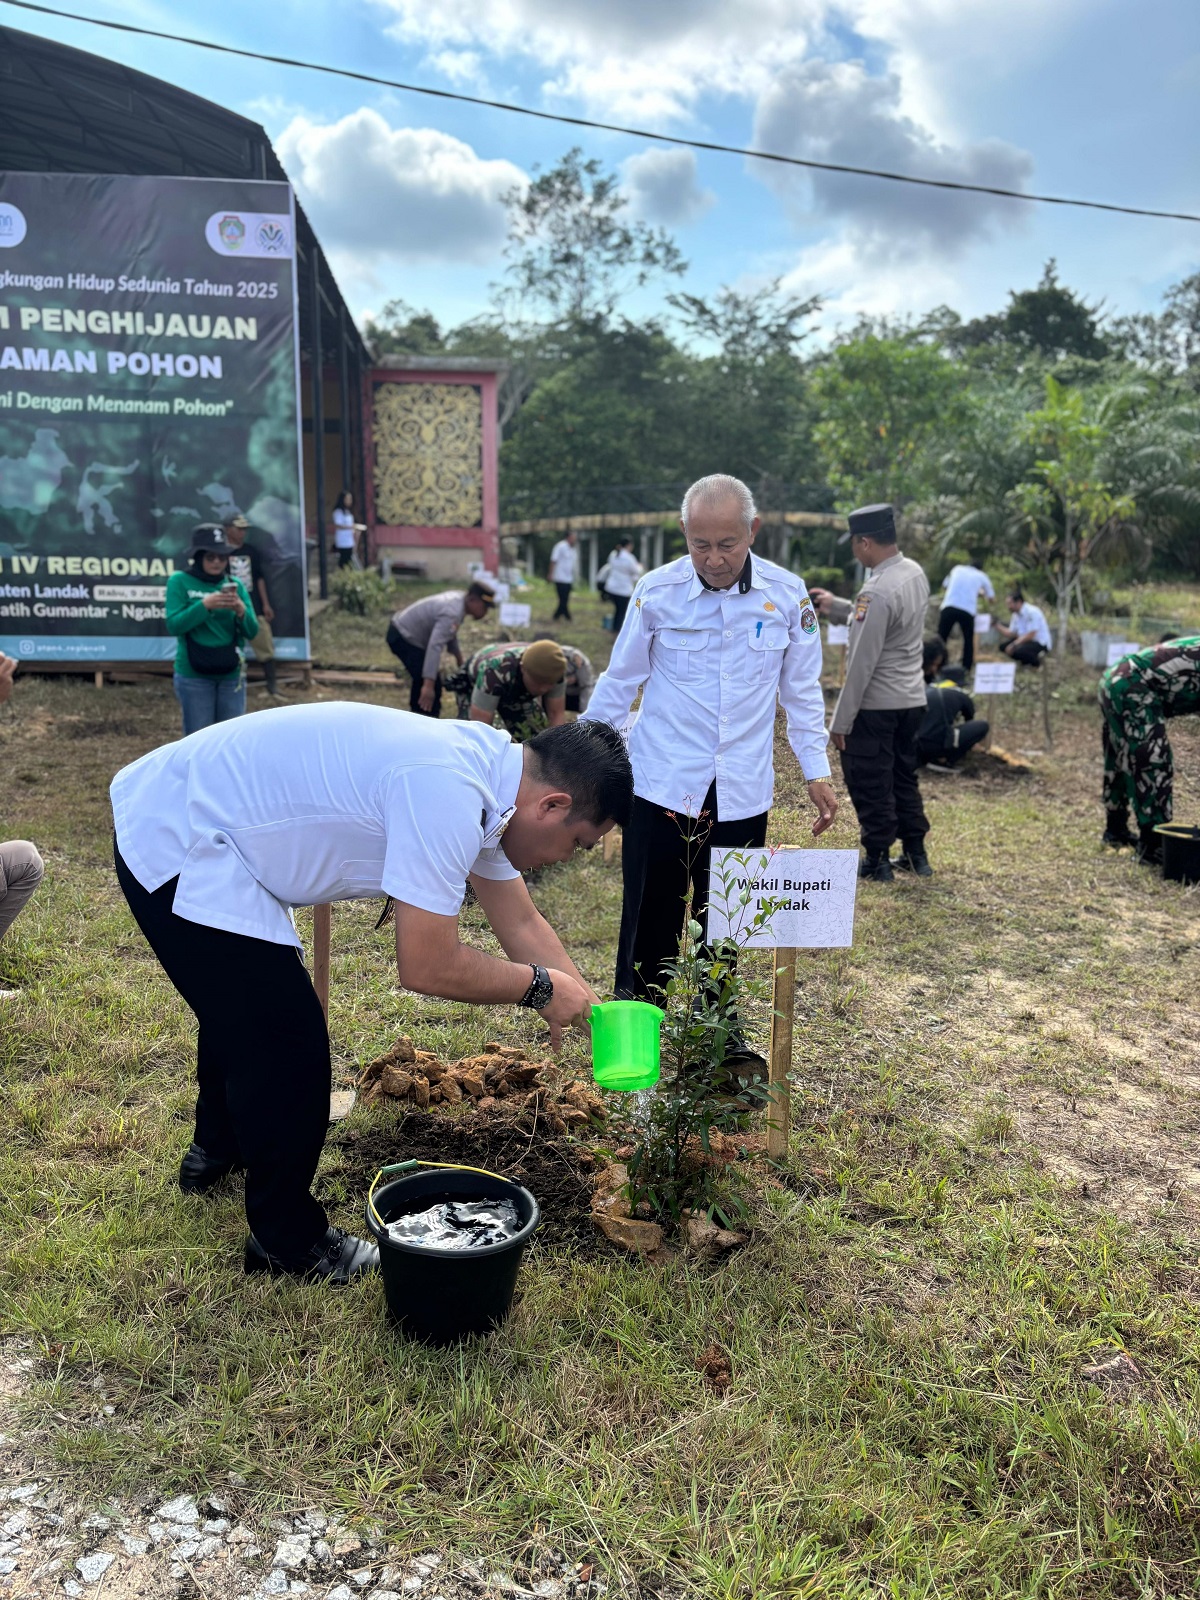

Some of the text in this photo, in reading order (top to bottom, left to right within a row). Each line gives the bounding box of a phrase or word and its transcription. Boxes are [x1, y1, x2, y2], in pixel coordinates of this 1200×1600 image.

[67, 274, 115, 294] Hidup
[118, 275, 180, 294] Sedunia
[184, 279, 233, 297] Tahun
[236, 281, 278, 299] 2025
[20, 307, 258, 341] PENGHIJAUAN
[0, 347, 223, 379] AMAN POHON
[16, 392, 83, 414] Dengan
[87, 395, 170, 415] Menanam
[173, 398, 234, 417] Pohon"
[12, 555, 39, 574] IV
[47, 556, 174, 577] REGIONAL
[34, 583, 90, 599] Landak
[140, 589, 159, 598] Juli
[33, 603, 110, 618] Gumantar
[737, 878, 831, 894] Wakil Bupati
